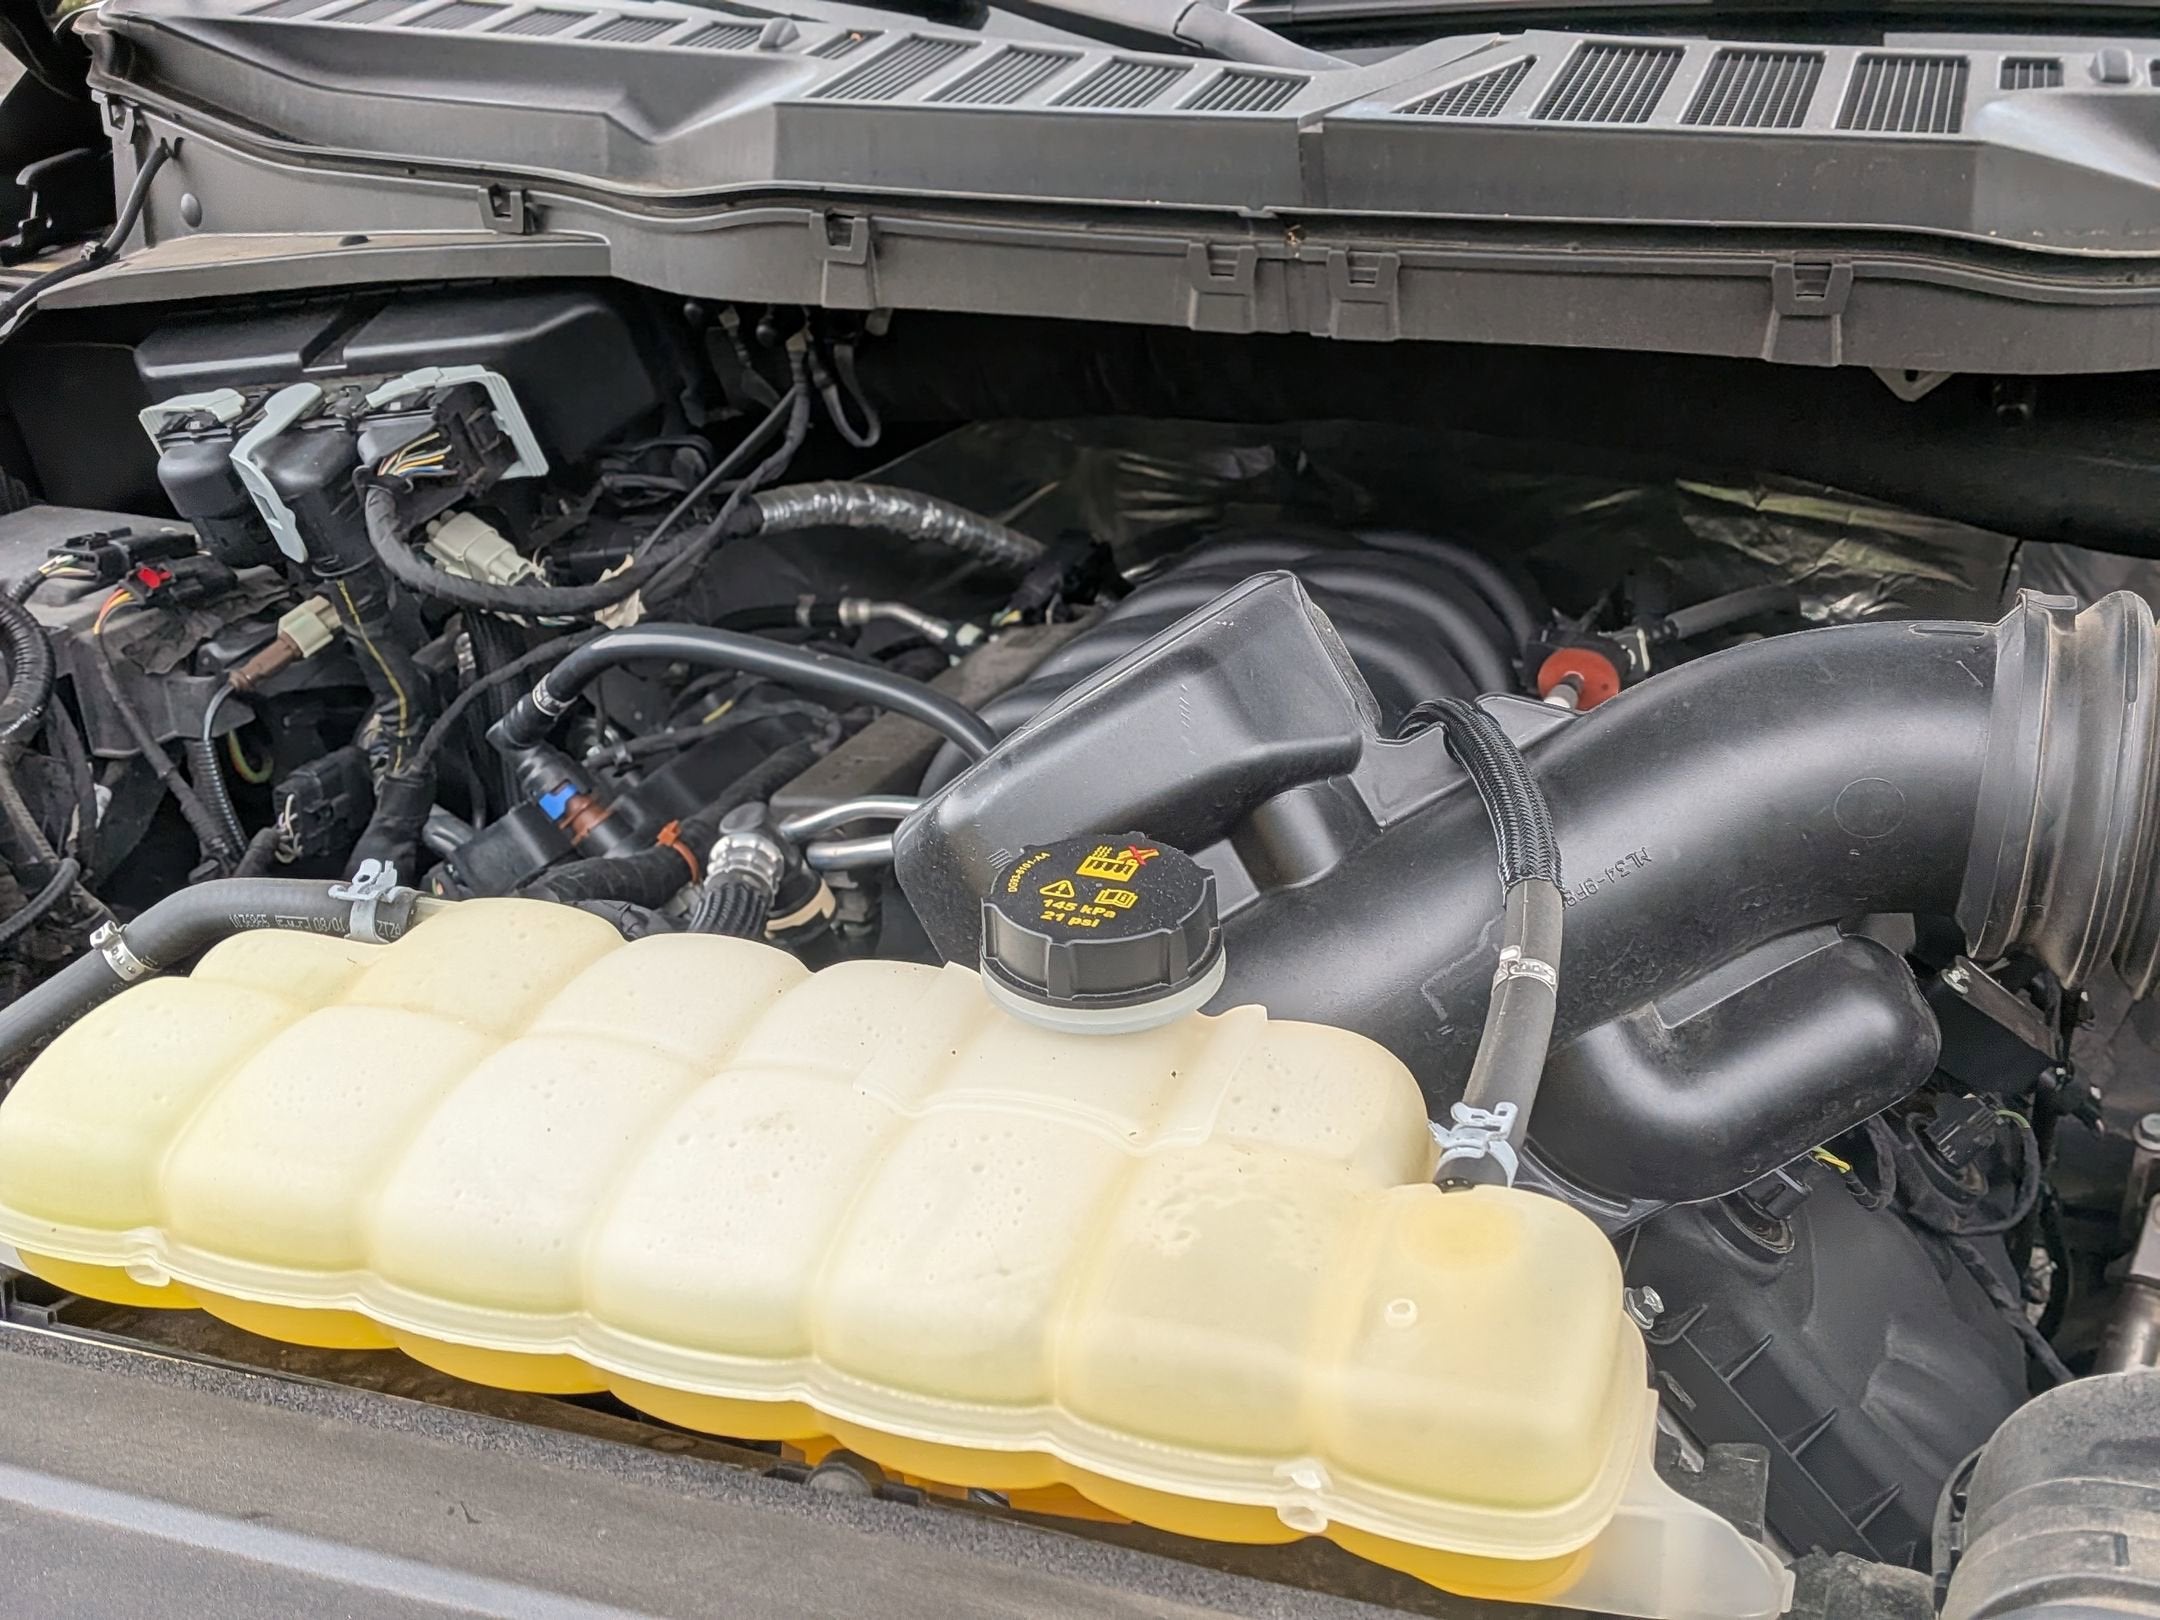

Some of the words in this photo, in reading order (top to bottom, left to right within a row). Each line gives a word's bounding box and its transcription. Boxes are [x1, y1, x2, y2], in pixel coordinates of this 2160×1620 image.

[1043, 899, 1078, 911] 145
[1080, 904, 1116, 918] kPa
[1040, 910, 1065, 921] 21
[1067, 916, 1101, 927] psi
